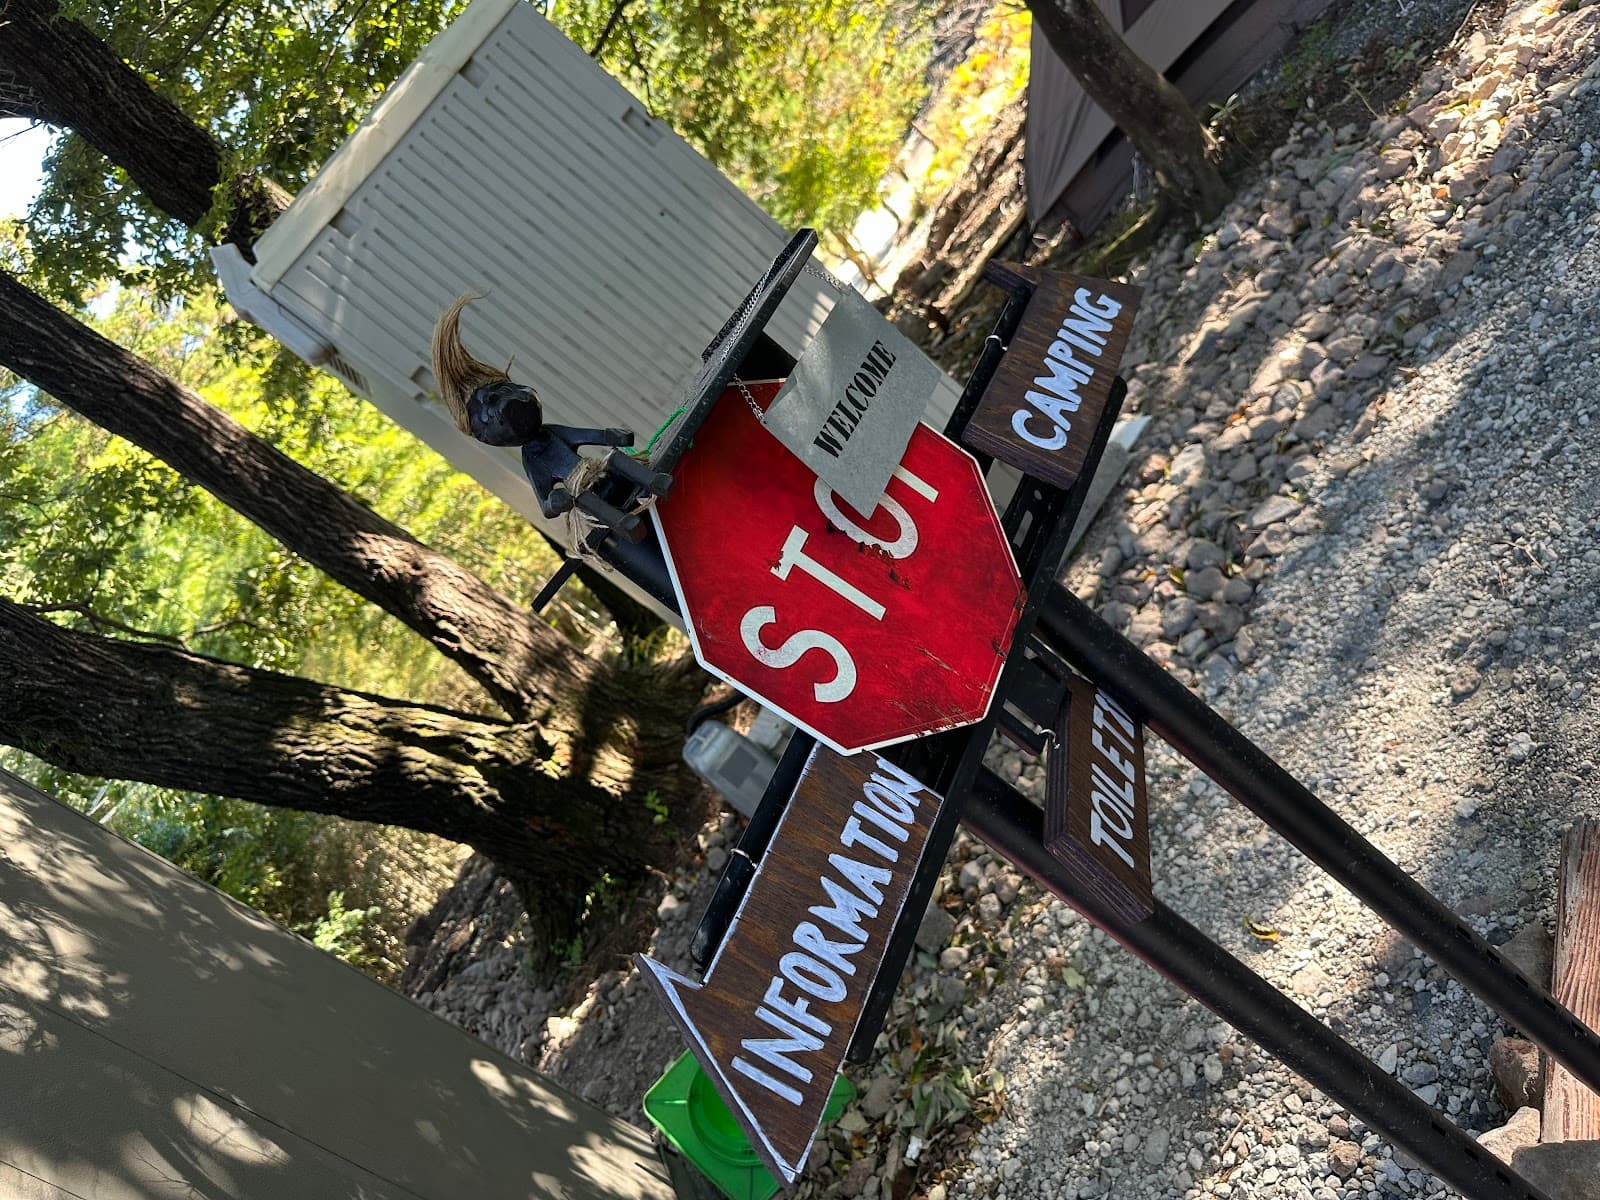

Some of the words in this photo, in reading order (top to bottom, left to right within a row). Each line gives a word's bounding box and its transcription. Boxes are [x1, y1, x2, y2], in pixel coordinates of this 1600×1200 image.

[812, 340, 897, 460] WELCOME
[1010, 287, 1122, 450] CAMPING
[731, 758, 926, 1105] INFORMATION
